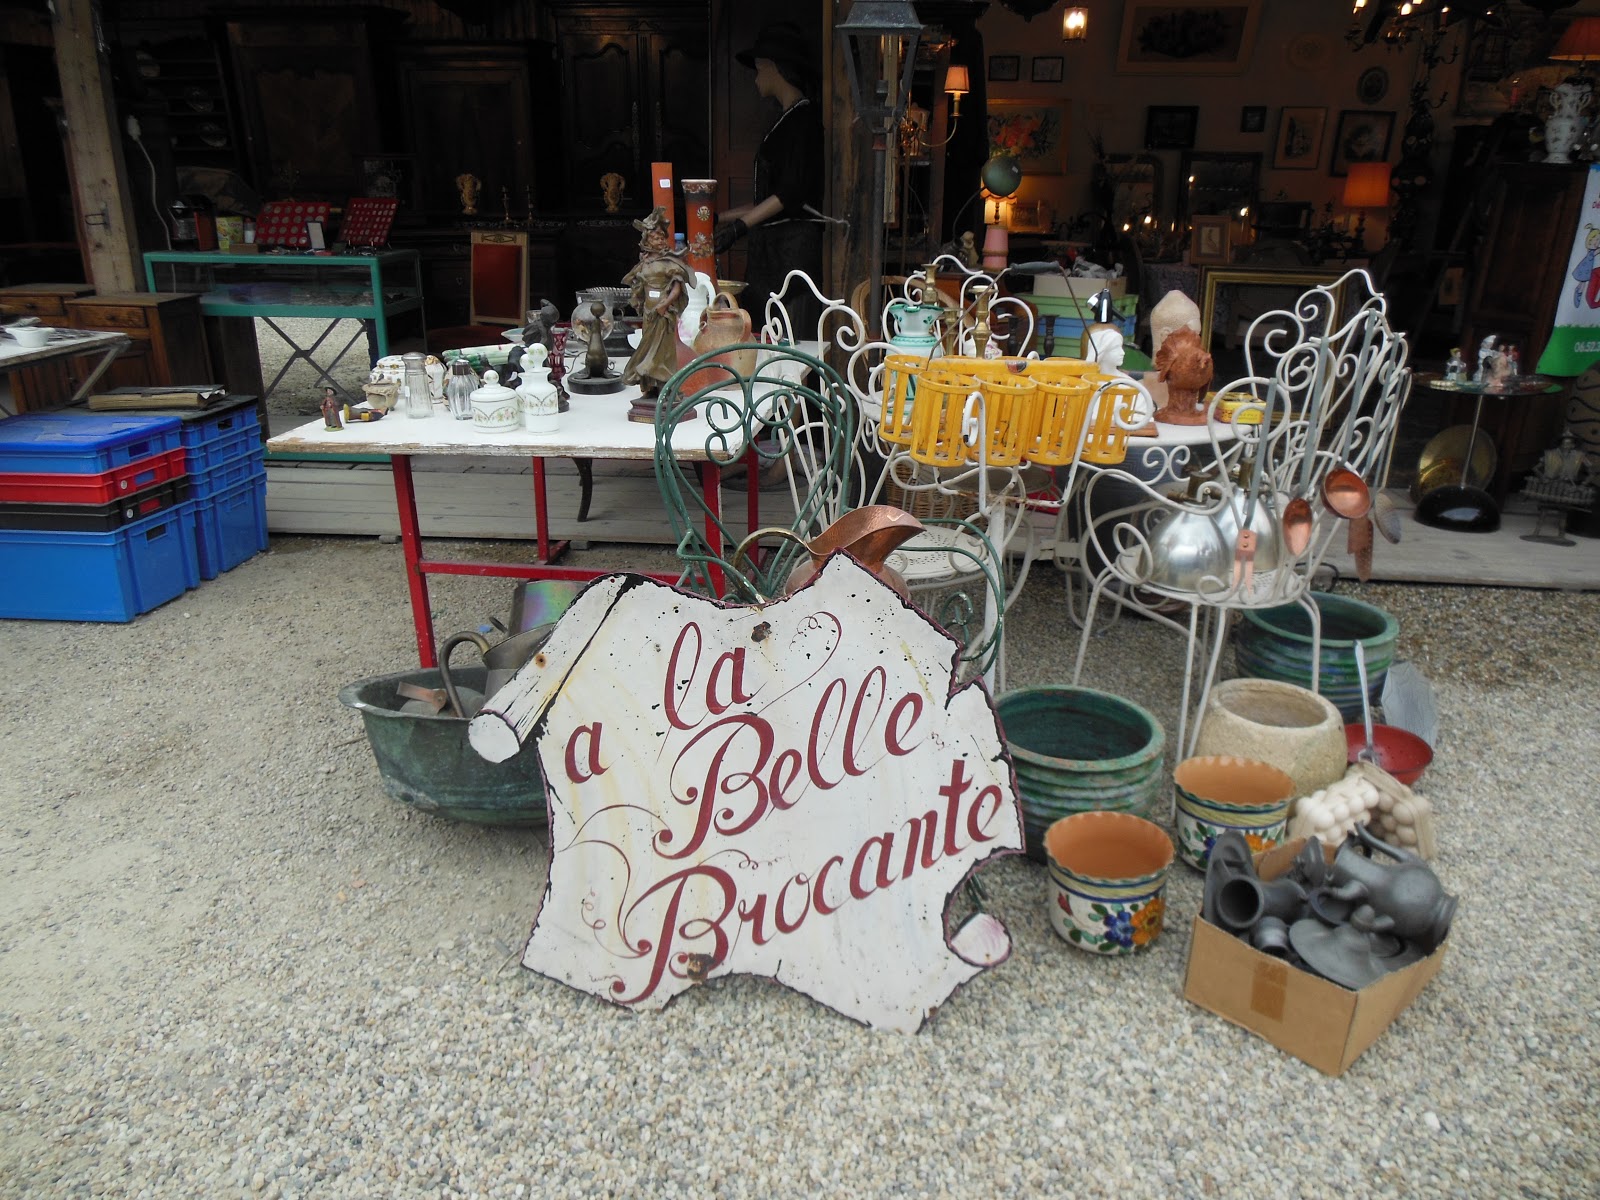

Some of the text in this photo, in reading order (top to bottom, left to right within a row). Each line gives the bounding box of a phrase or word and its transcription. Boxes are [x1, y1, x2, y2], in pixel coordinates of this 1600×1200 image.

[564, 621, 760, 785] a la
[652, 665, 926, 860] Belle
[608, 758, 1003, 1005] Brocante
